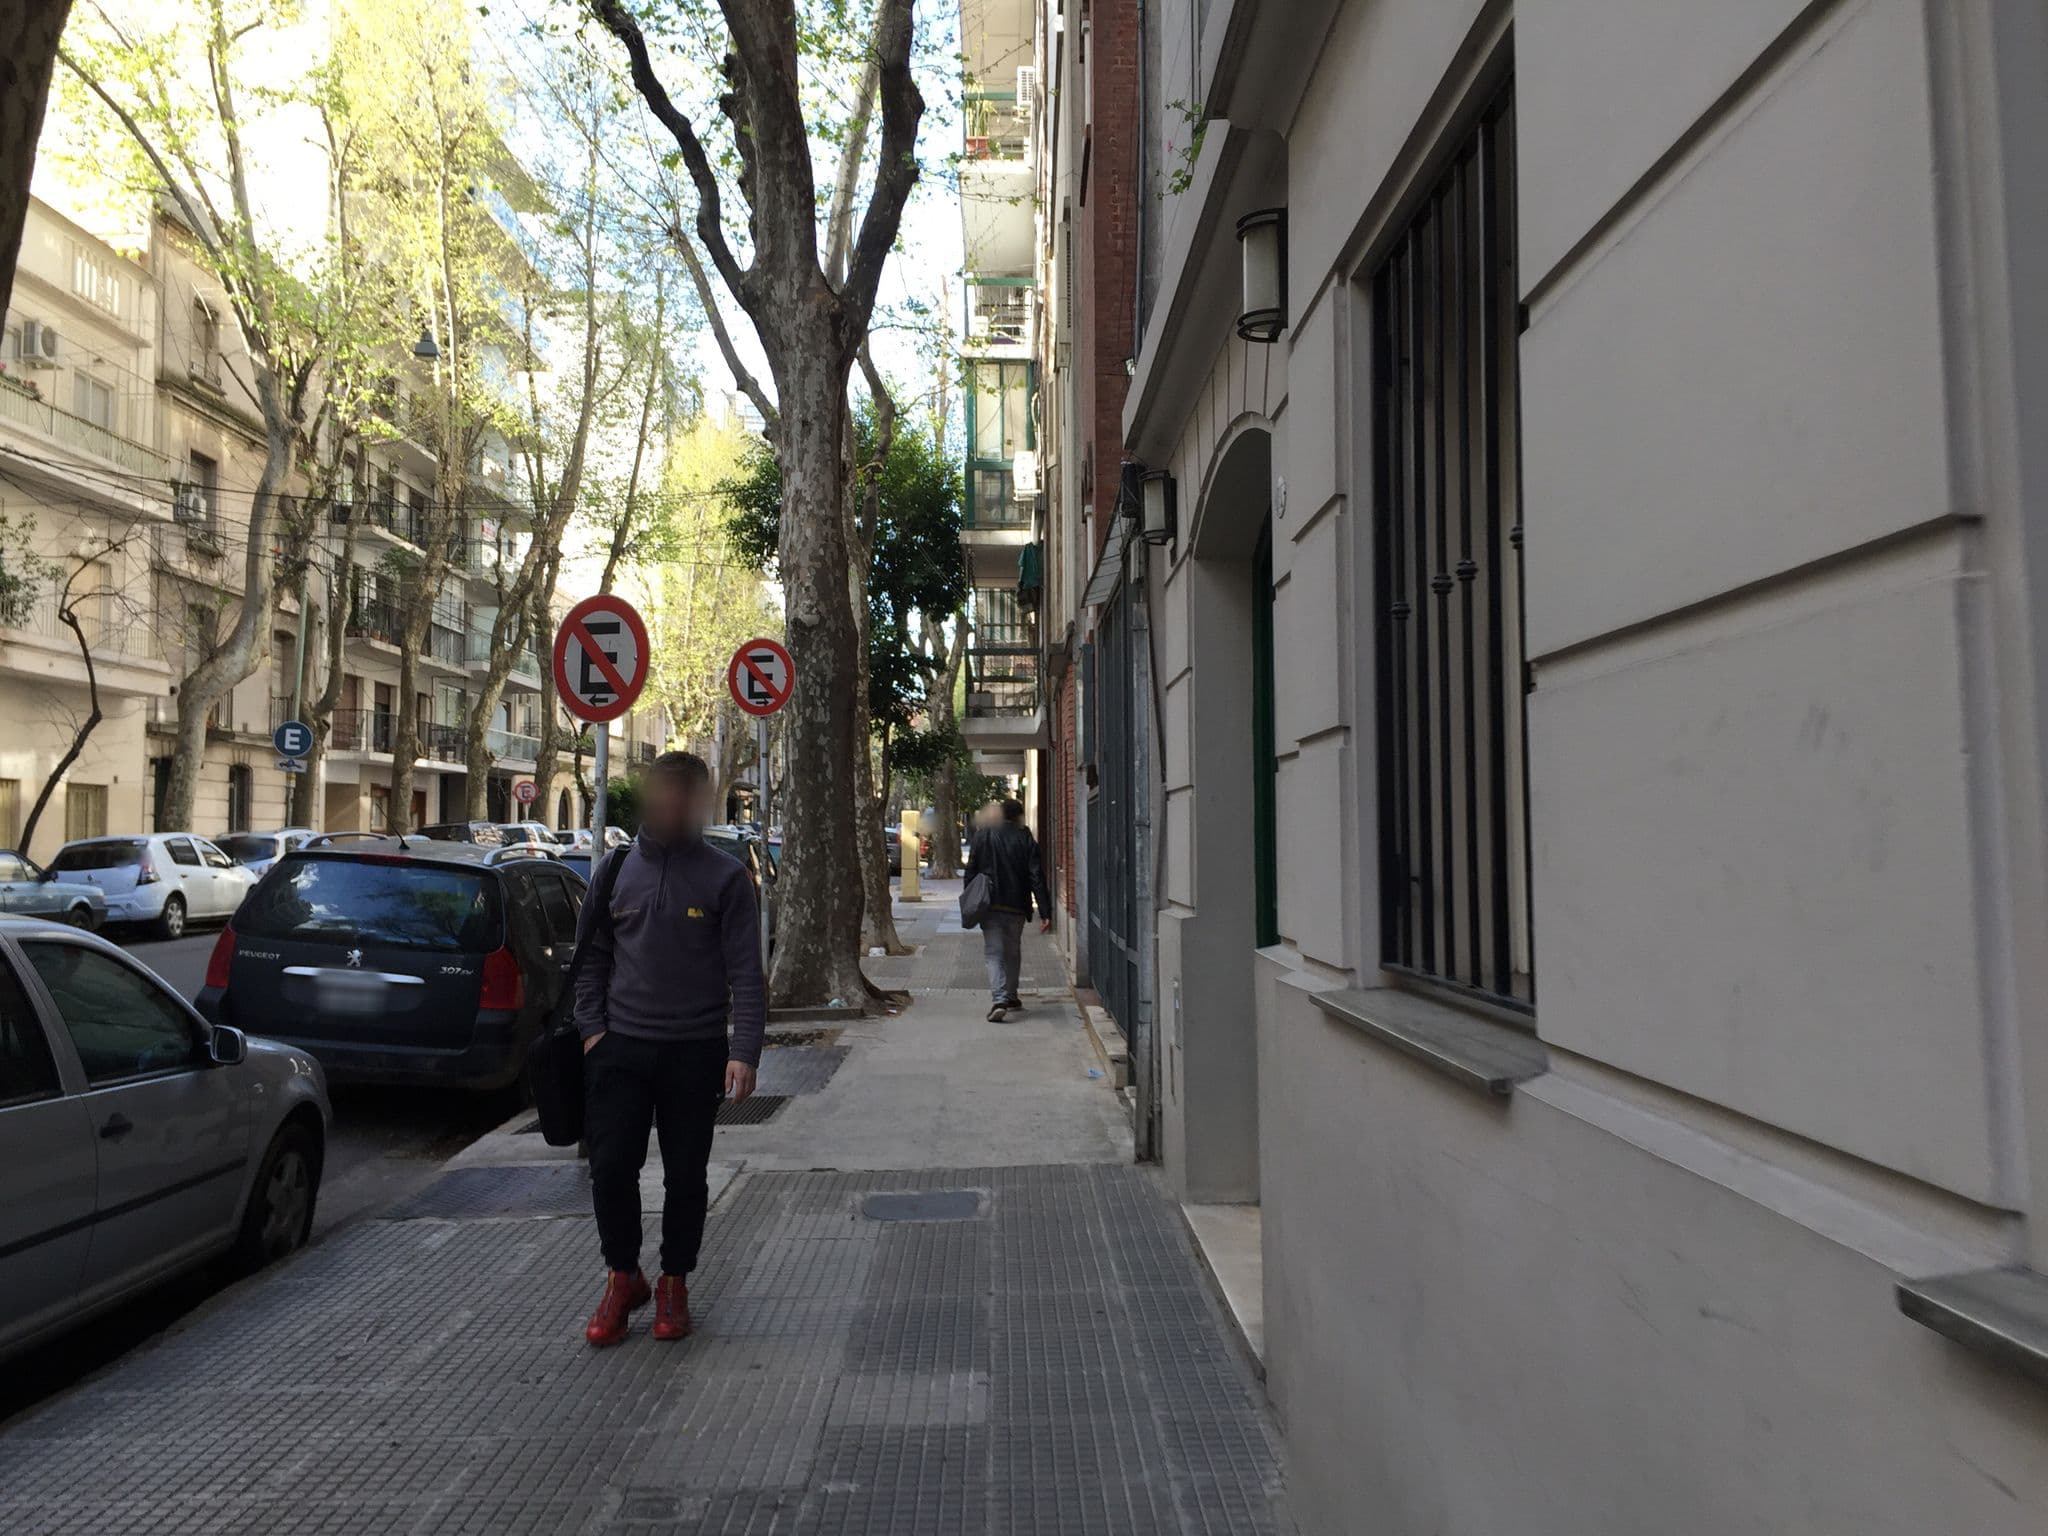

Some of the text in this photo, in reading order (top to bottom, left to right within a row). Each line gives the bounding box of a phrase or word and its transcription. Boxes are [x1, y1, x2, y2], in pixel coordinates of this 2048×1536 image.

[579, 622, 621, 694] E
[747, 655, 775, 699] E
[284, 728, 301, 750] E
[239, 949, 281, 960] PEUGEOT
